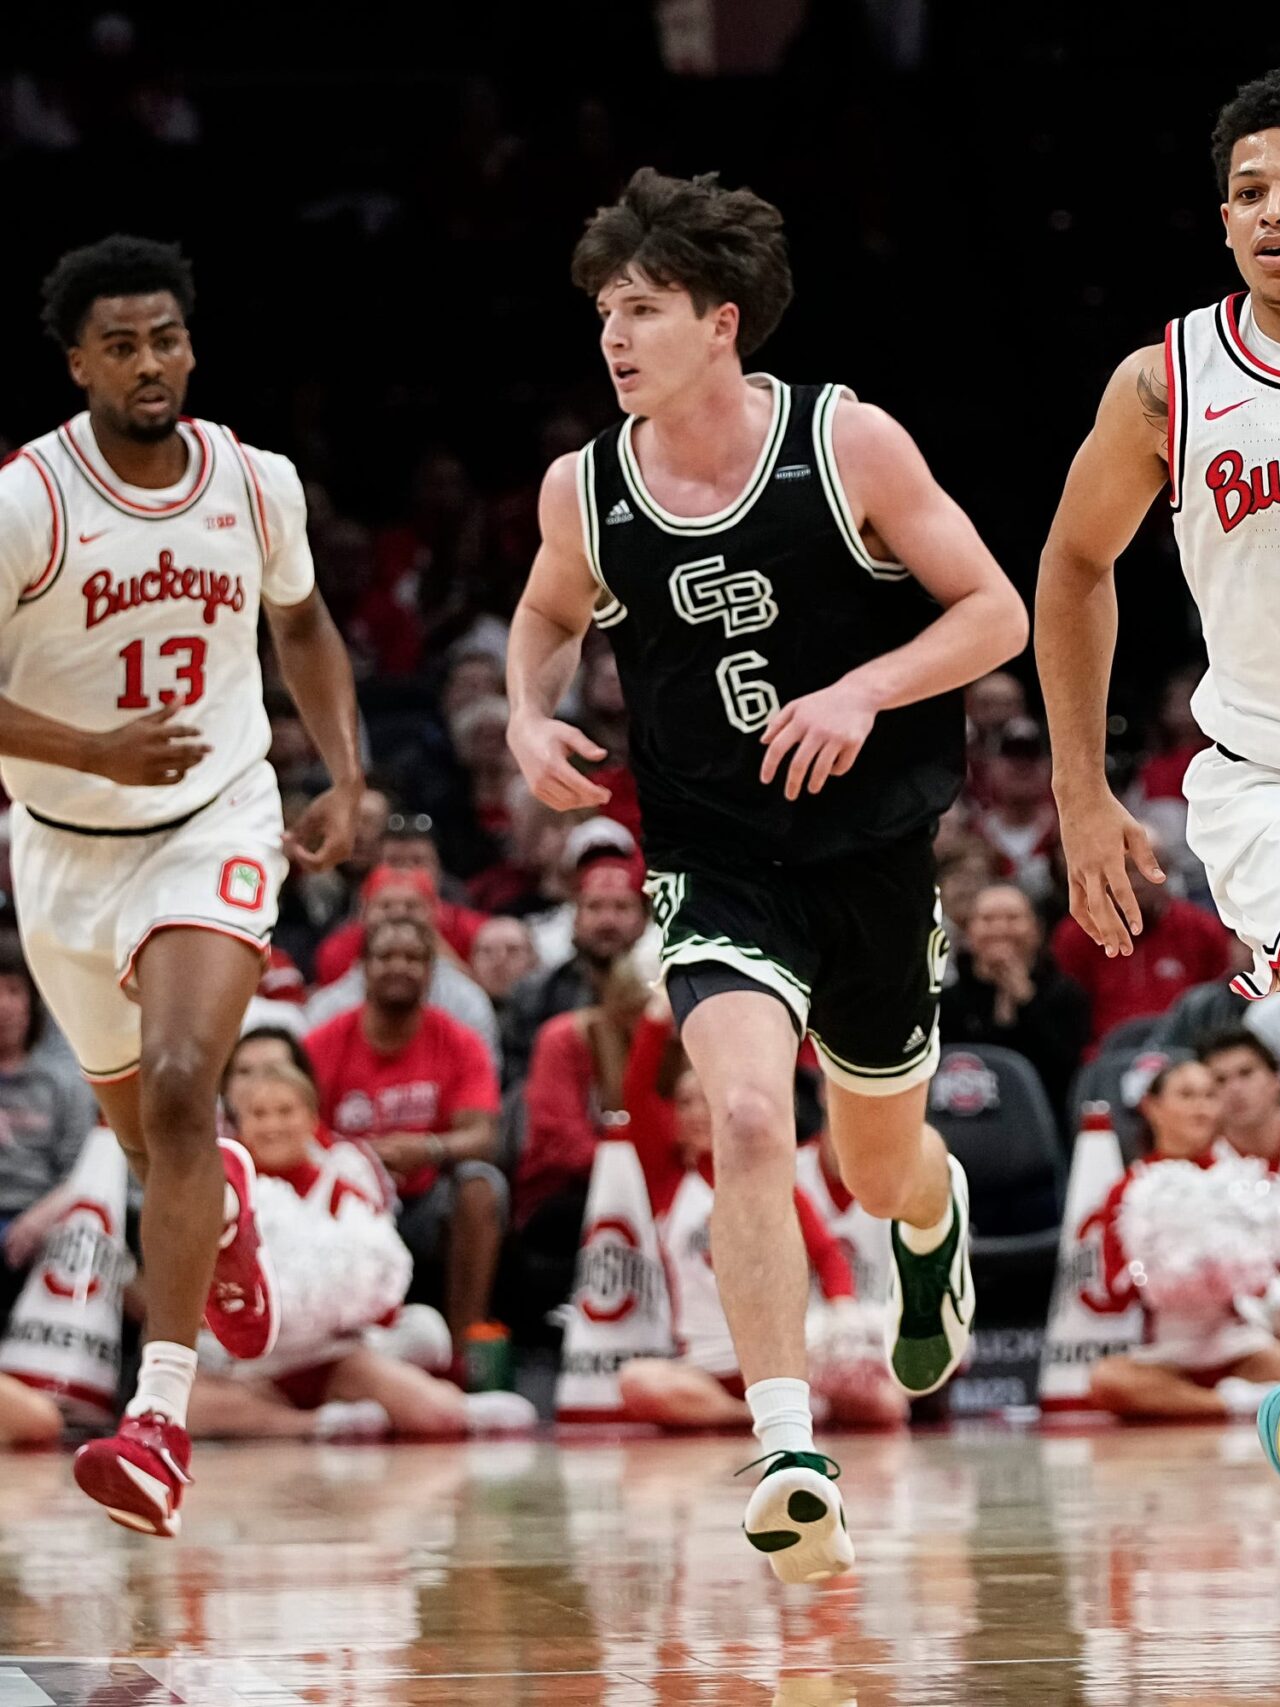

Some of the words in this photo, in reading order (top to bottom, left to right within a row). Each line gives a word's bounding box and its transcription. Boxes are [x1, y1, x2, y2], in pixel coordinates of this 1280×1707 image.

[82, 550, 244, 630] Buckeyes
[668, 554, 780, 639] GB
[117, 636, 208, 709] 13
[715, 650, 781, 734] 6
